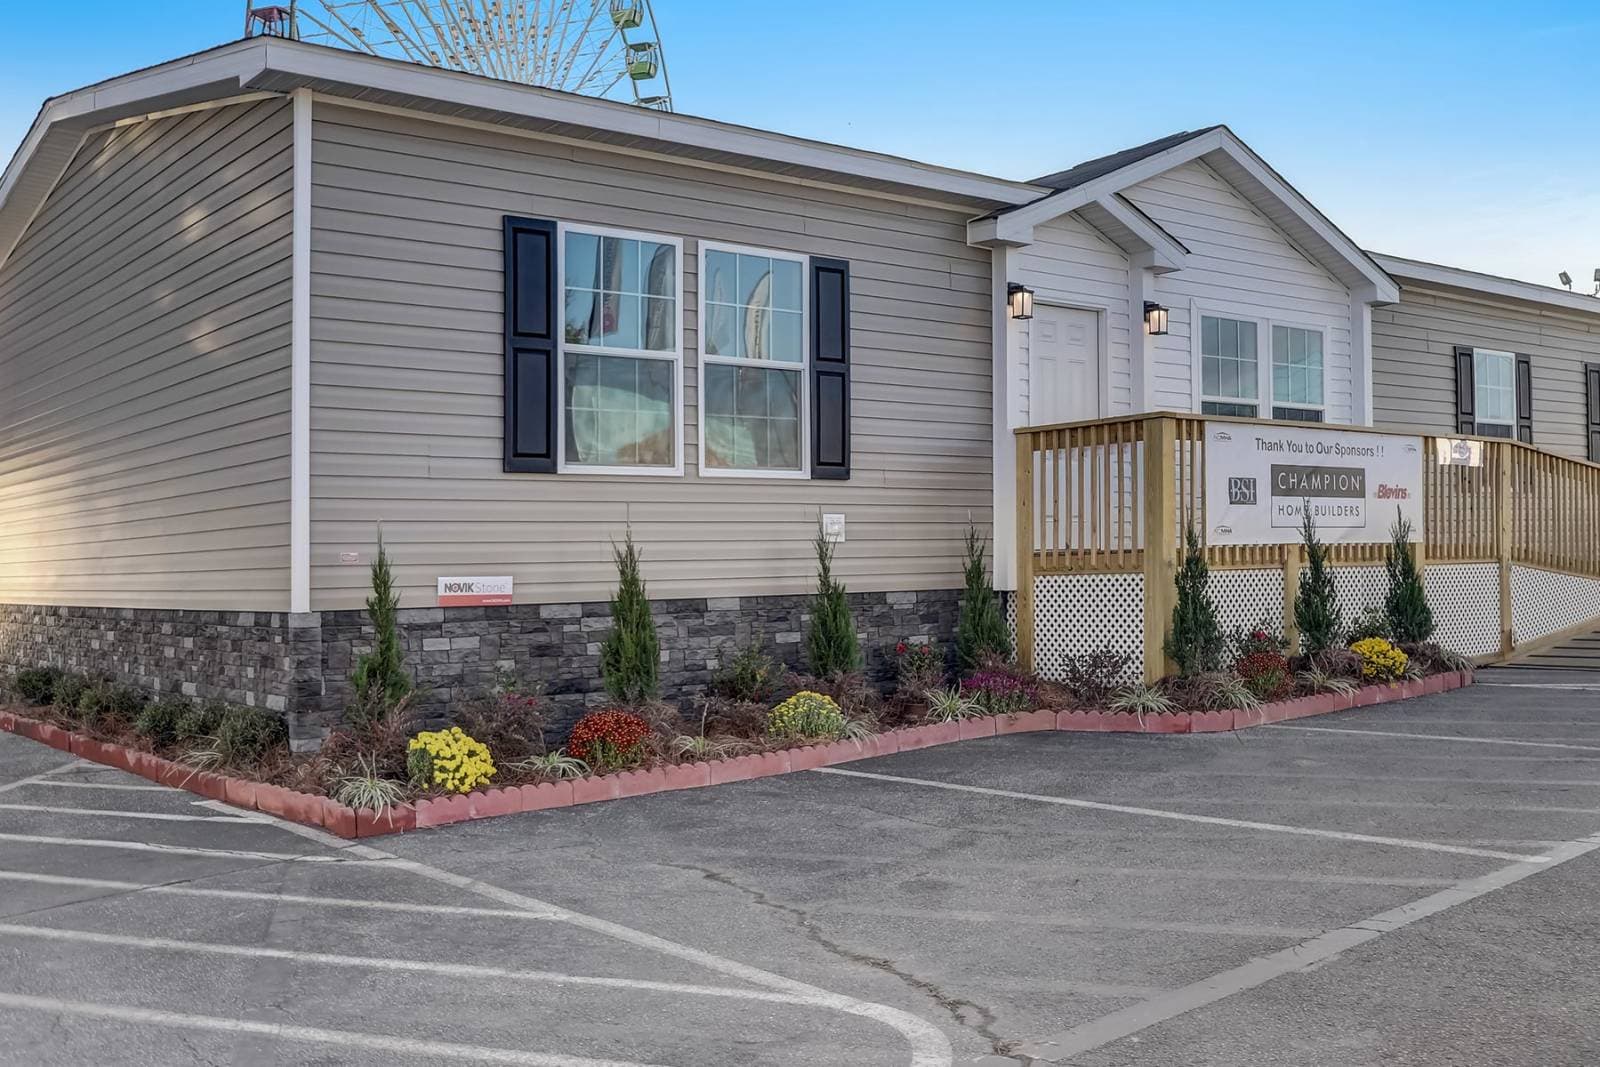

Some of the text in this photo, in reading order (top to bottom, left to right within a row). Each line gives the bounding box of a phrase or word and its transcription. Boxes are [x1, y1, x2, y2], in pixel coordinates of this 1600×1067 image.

[1255, 438, 1284, 452] Thank
[1286, 440, 1303, 454] You
[1306, 441, 1314, 455] to
[1316, 442, 1333, 455] Our
[1335, 443, 1375, 459] Sponsors
[1278, 472, 1362, 491] CHAMPION
[1278, 504, 1360, 517] HOM BUILDERS
